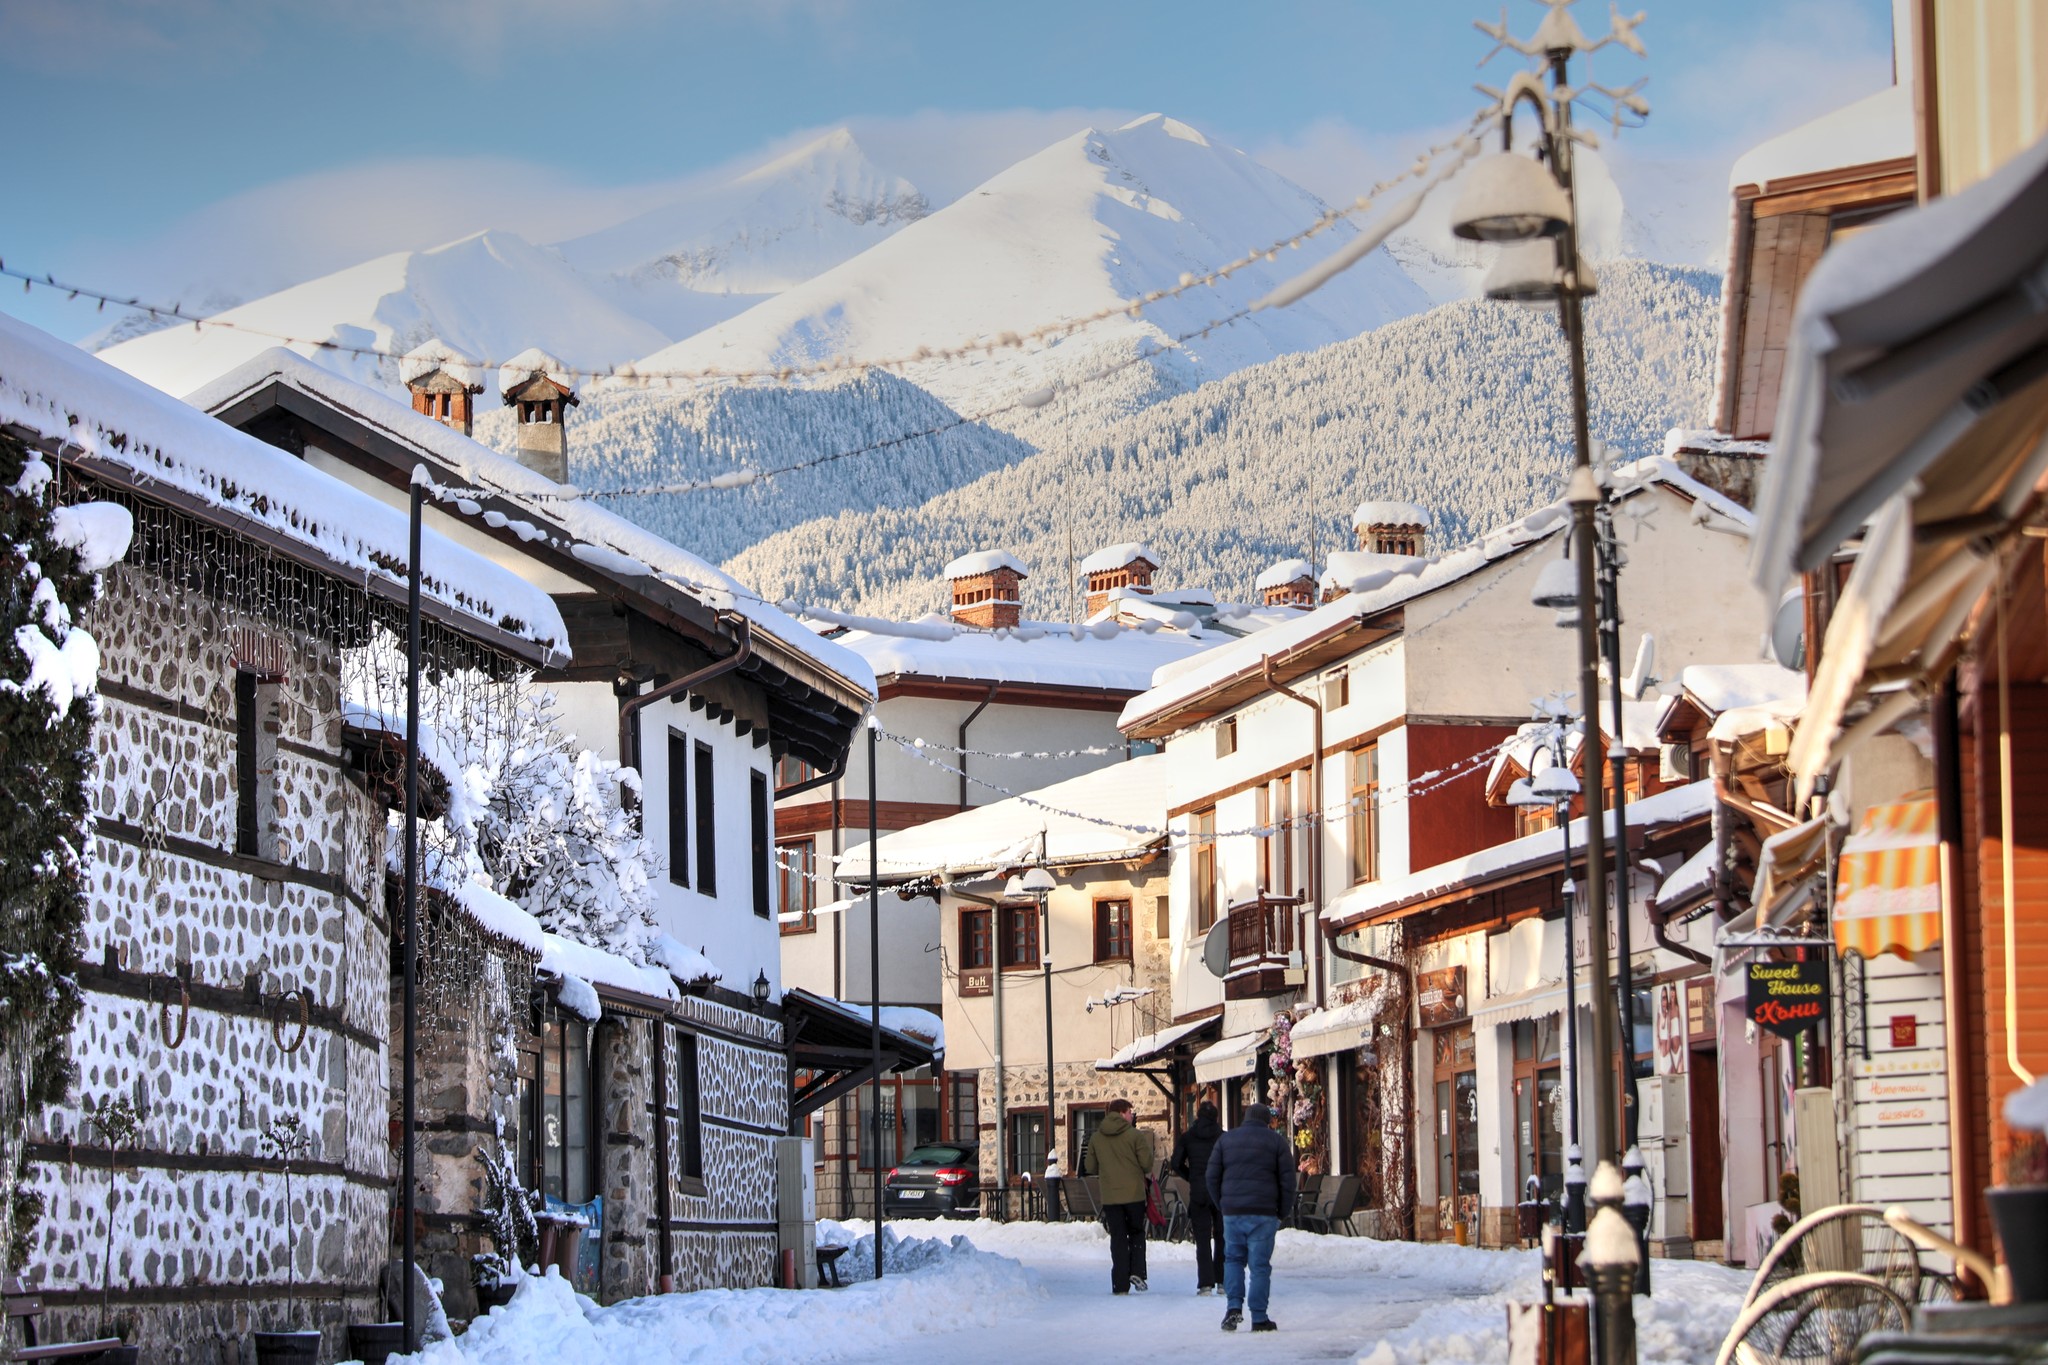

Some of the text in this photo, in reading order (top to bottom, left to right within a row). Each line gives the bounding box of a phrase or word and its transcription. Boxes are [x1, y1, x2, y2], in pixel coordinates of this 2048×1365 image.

[1750, 964, 1799, 979] Sweet
[1767, 980, 1822, 995] House
[1755, 1000, 1822, 1025] Хъни
